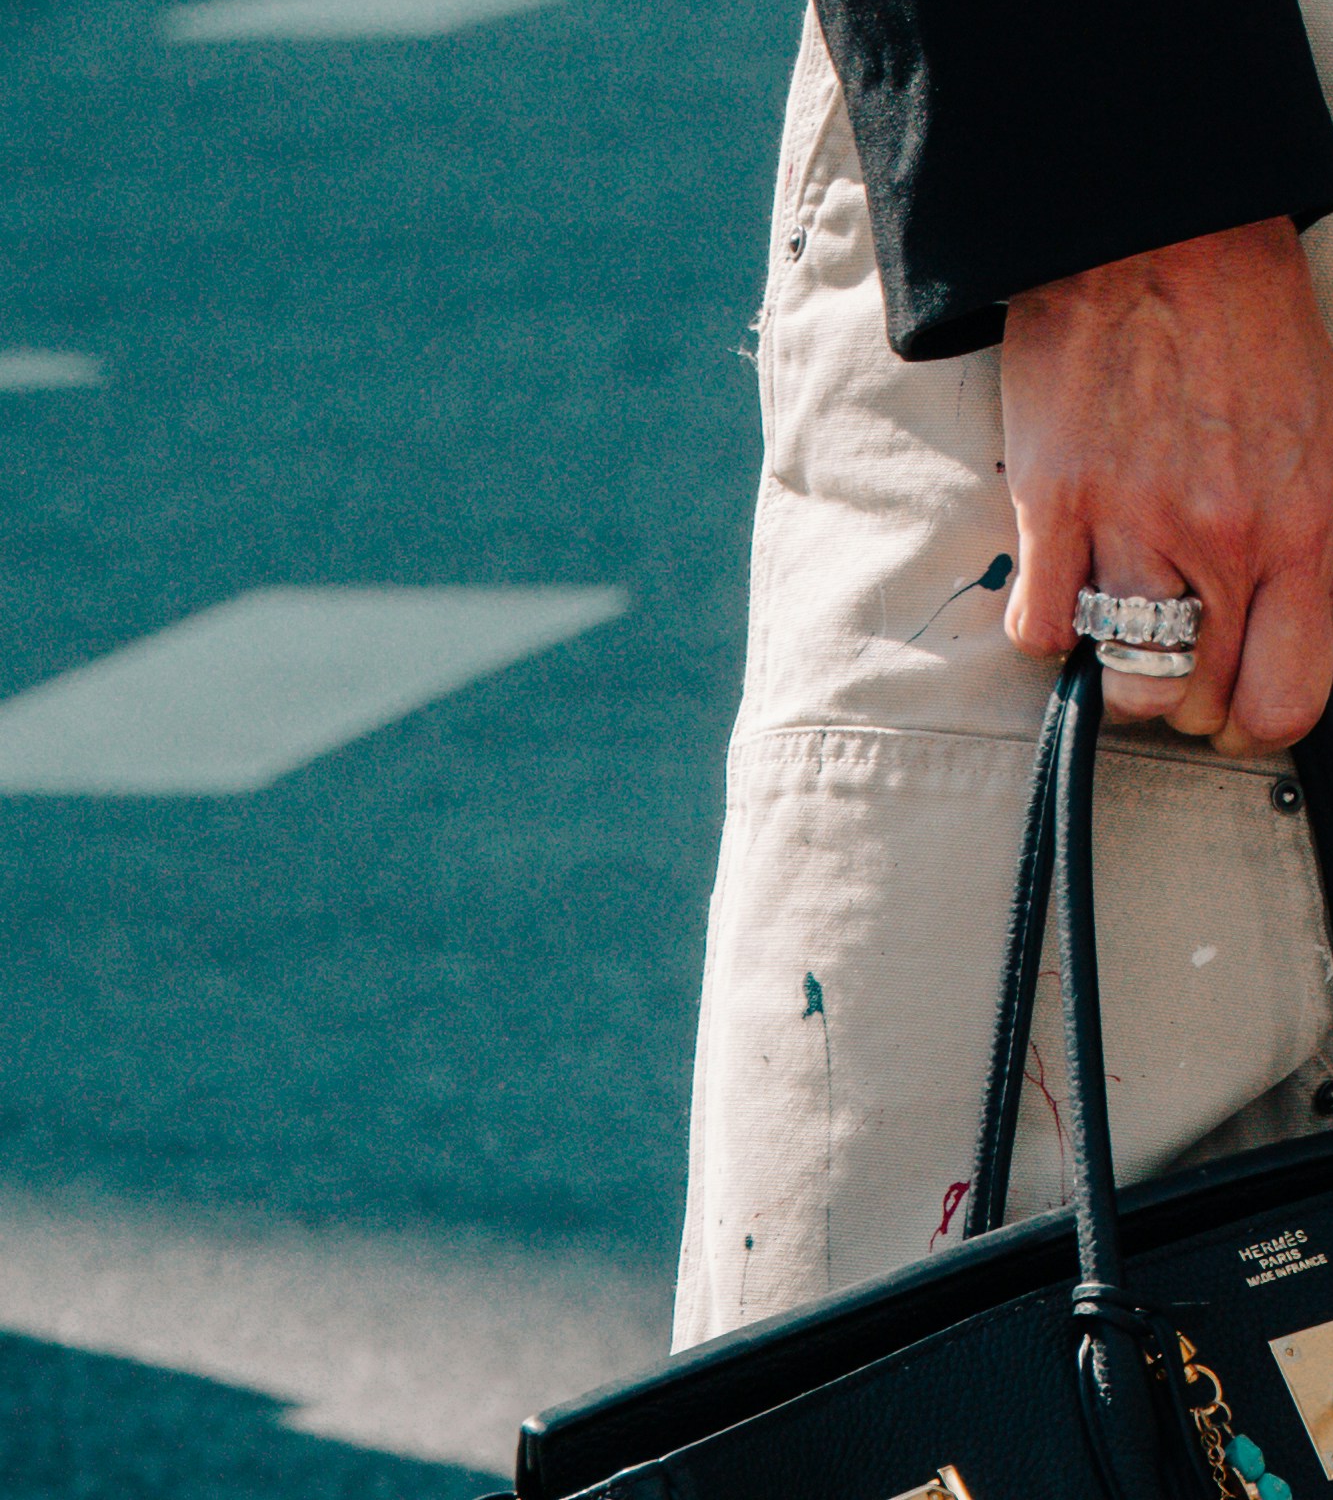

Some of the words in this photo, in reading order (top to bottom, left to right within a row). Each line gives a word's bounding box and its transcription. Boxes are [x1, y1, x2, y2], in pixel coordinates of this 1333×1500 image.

[1238, 1229, 1308, 1261] HERMÈS
[1259, 1248, 1302, 1269] PARIS
[1245, 1270, 1276, 1288] MADE
[1275, 1266, 1288, 1278] IN
[1285, 1253, 1328, 1275] FRANCE
